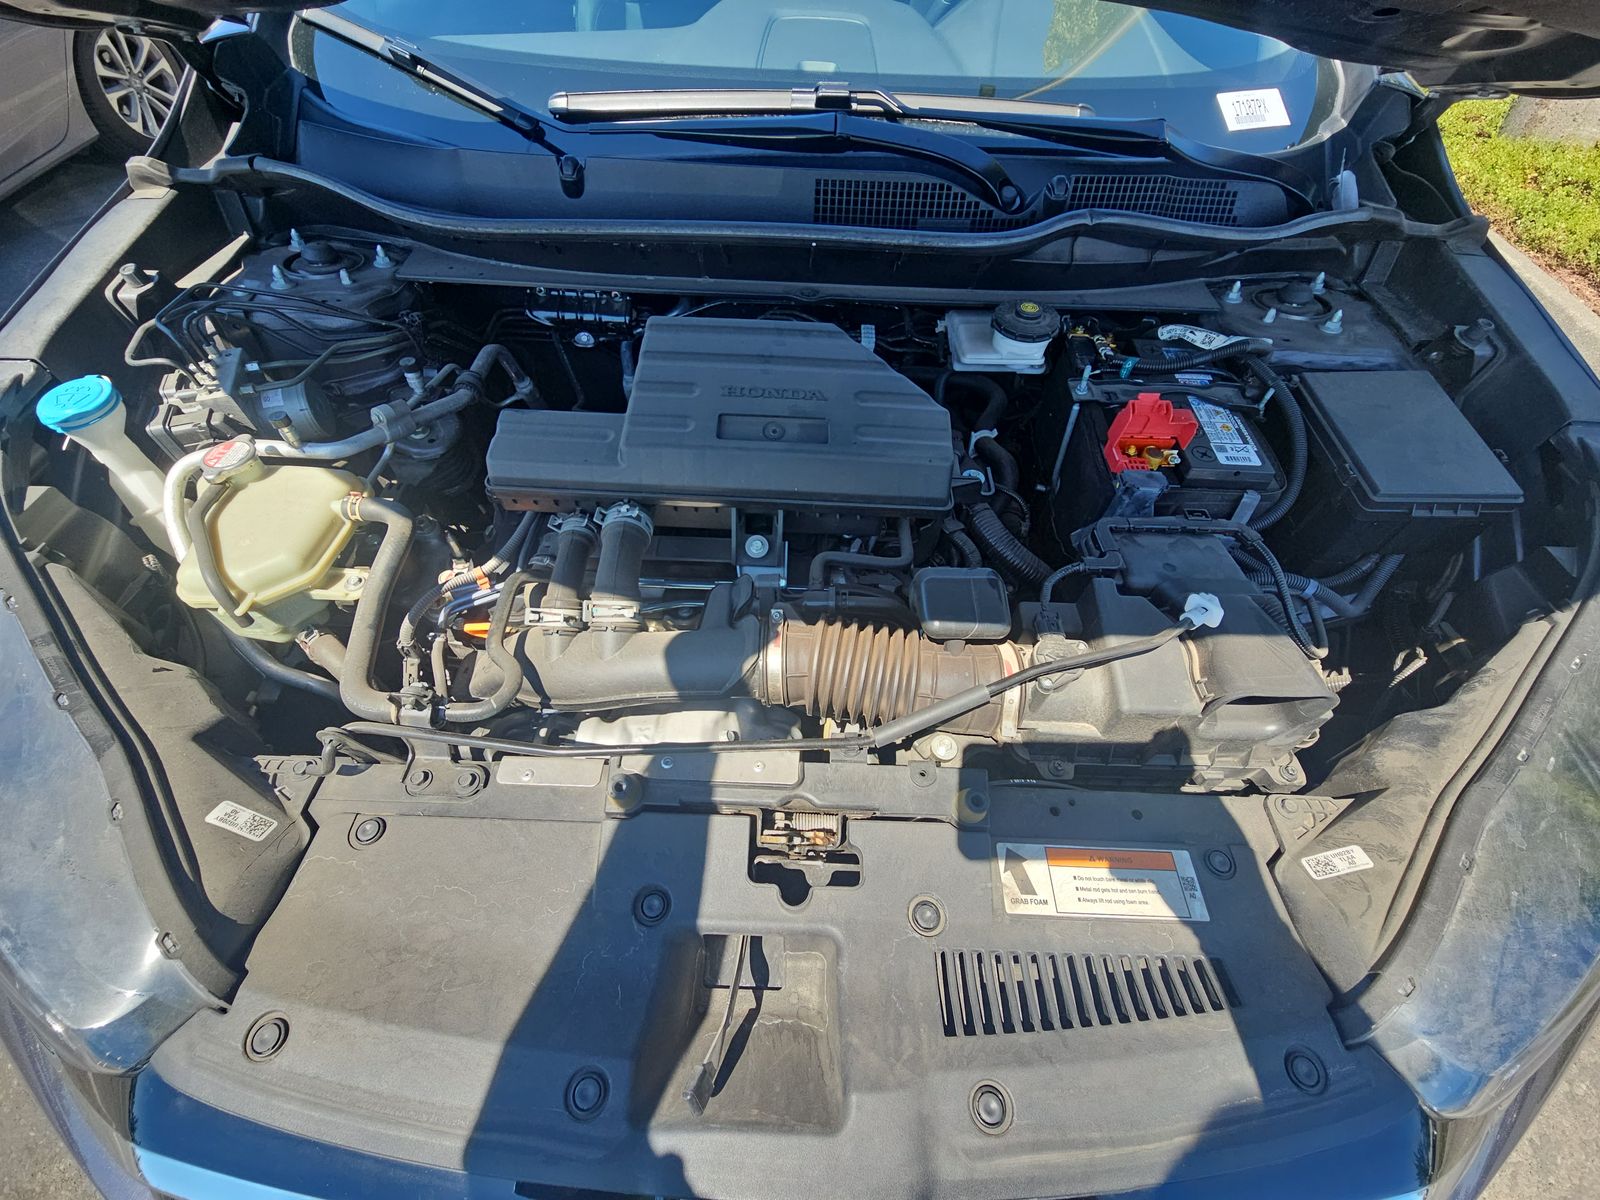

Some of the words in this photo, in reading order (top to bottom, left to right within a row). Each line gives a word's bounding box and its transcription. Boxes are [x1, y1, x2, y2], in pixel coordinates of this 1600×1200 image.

[720, 386, 828, 401] HONDA
[1096, 855, 1133, 863] WARNING
[1010, 897, 1029, 905] GRAB
[1030, 898, 1049, 906] FOAM
